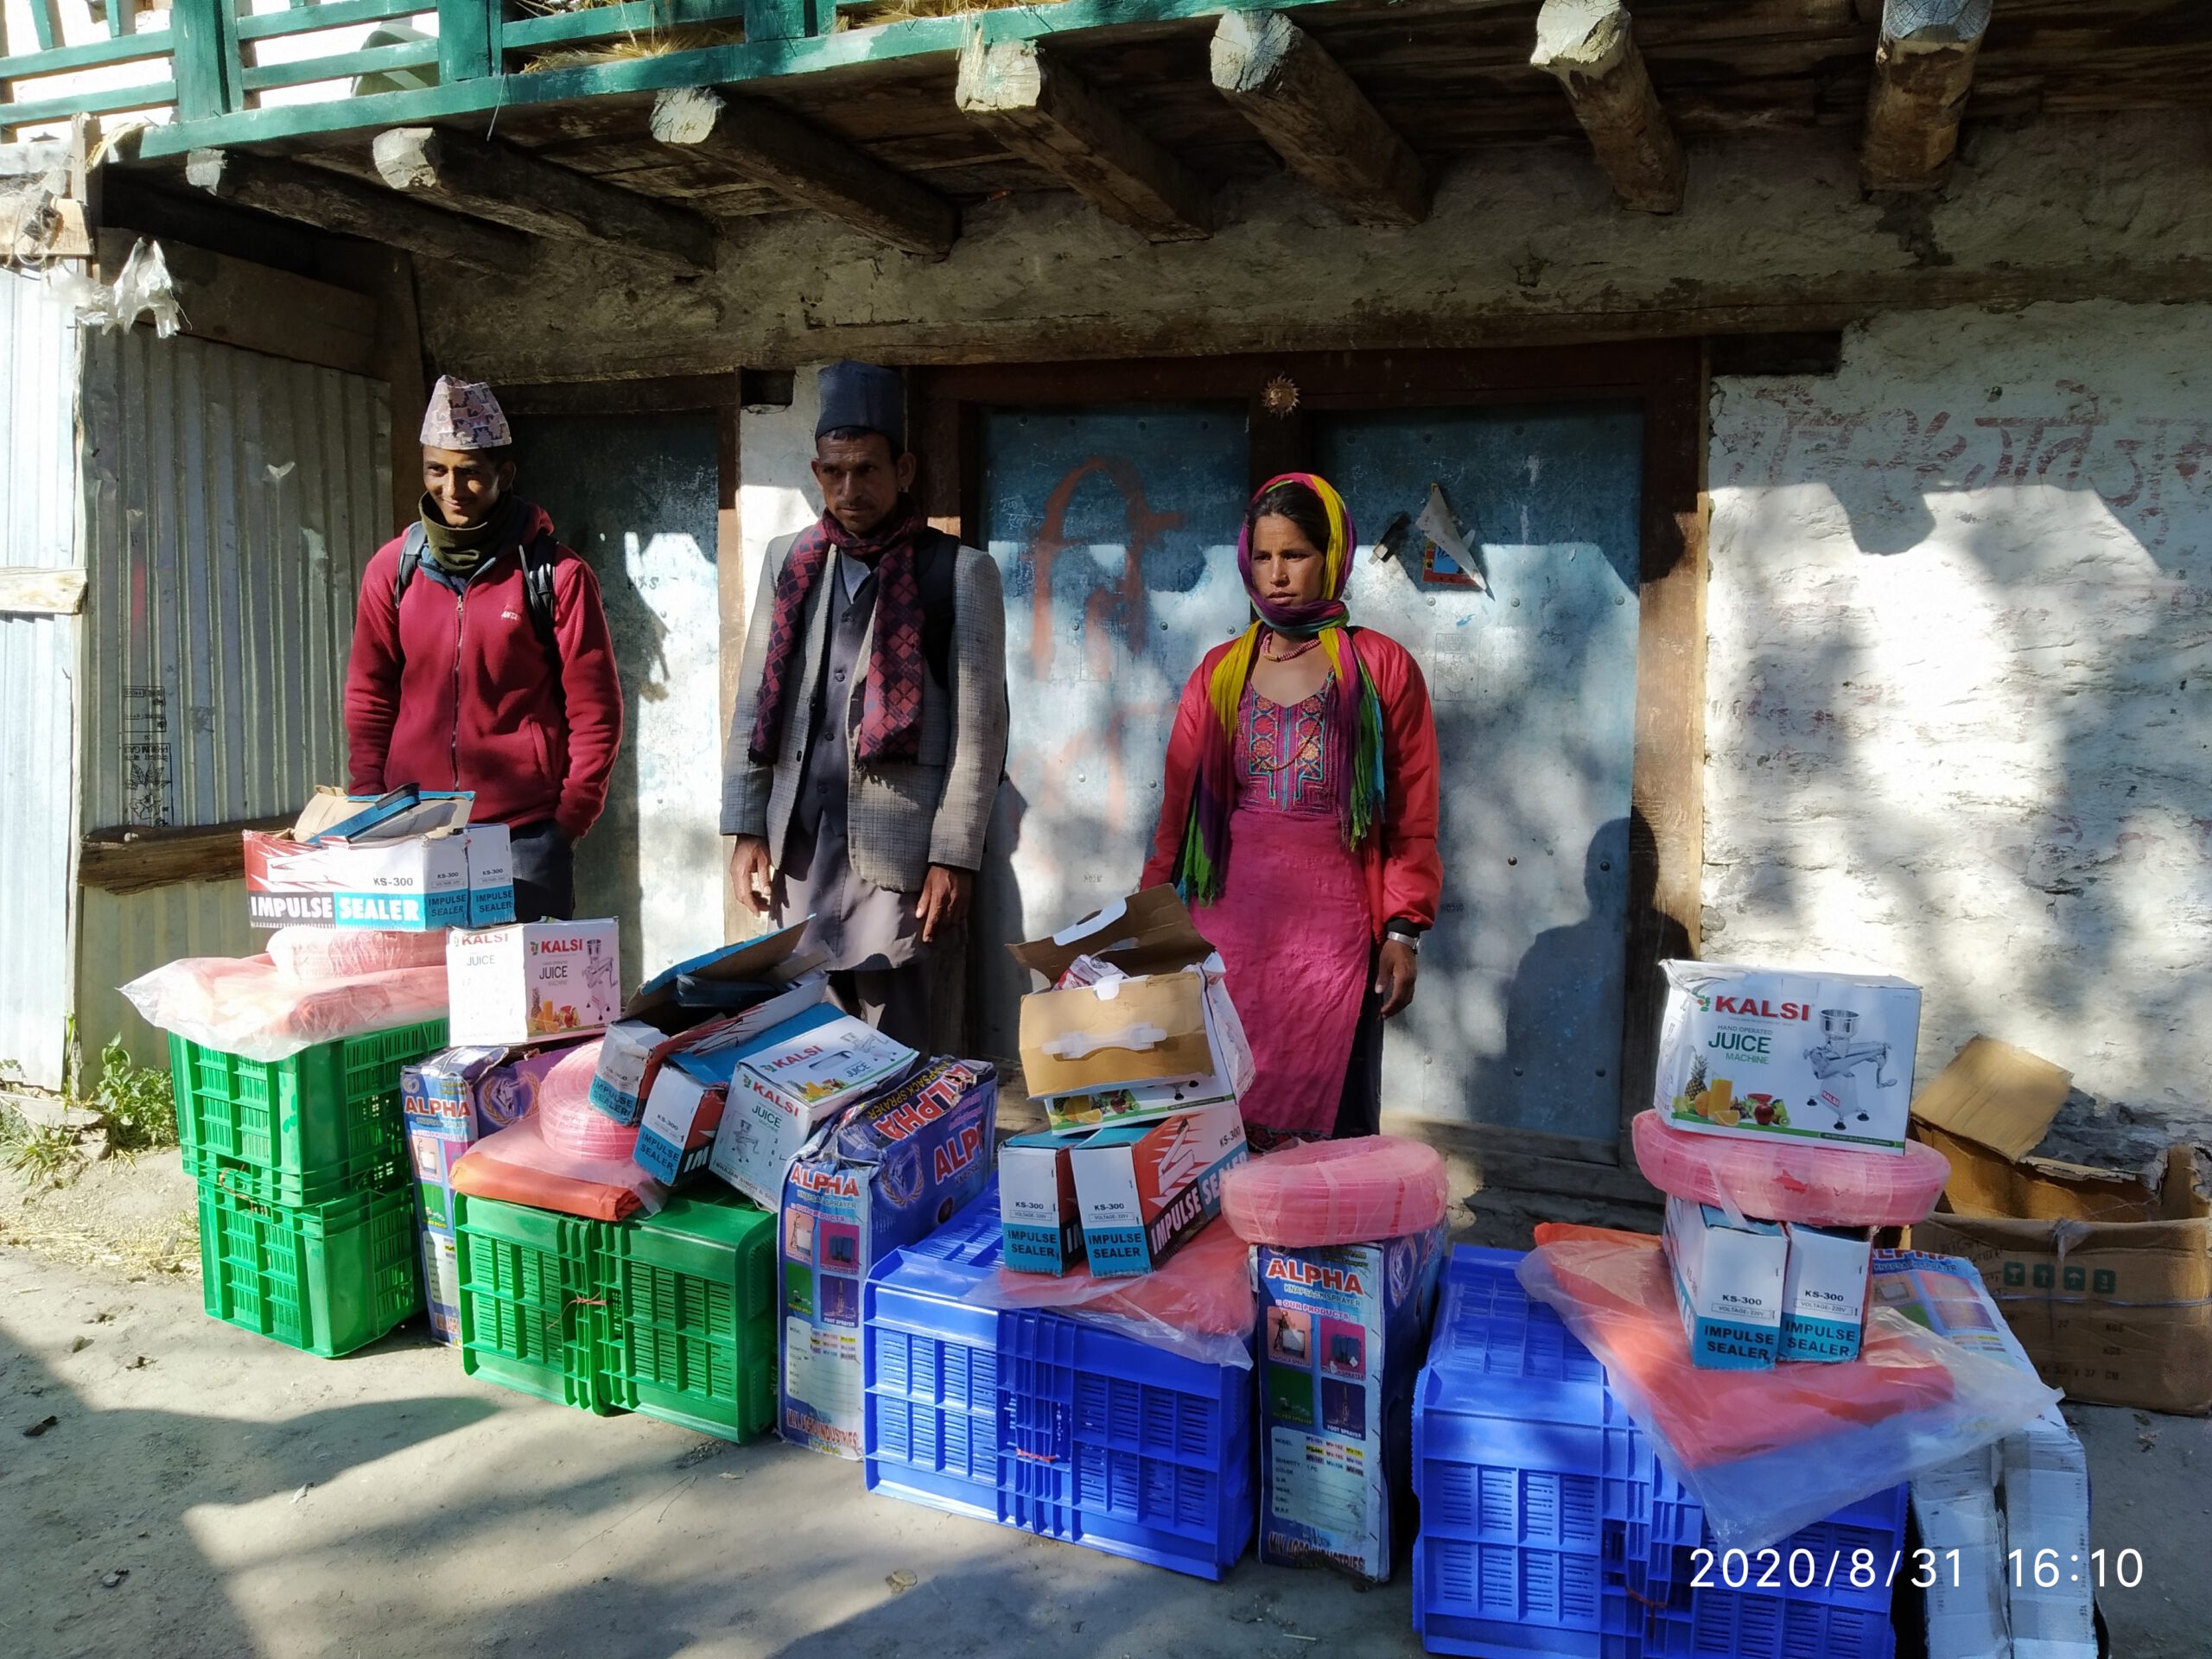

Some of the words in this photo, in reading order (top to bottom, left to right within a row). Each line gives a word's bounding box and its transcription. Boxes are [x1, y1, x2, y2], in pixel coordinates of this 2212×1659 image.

[373, 877, 413, 887] KS-300
[429, 894, 466, 906] IMPULSE
[476, 890, 512, 902] IMPULSE
[251, 893, 333, 918] IMPULSE
[340, 898, 420, 921] SEALER
[431, 906, 464, 917] SEALER
[480, 901, 512, 912] SEALER
[461, 933, 508, 946] KALSI
[541, 939, 583, 953] KALSI
[467, 955, 496, 966] JUICE
[539, 966, 568, 980] JUICE
[1715, 995, 1810, 1021] KALSI
[1738, 1027, 1773, 1036] OPERATED
[1708, 1033, 1771, 1053] JUICE
[772, 1046, 824, 1069] KALSI
[1726, 1052, 1770, 1065] MACHINE
[846, 1062, 871, 1077] JUICE
[595, 1080, 632, 1108] IMPULSE
[753, 1081, 799, 1119] KALSI
[1822, 1090, 1840, 1107] KALSI
[404, 1095, 471, 1118] ALPHA
[593, 1091, 631, 1116] SEALER
[868, 1091, 907, 1120] SPRAYER
[752, 1105, 782, 1128] JUICE
[1220, 1126, 1242, 1148] KS-300
[642, 1131, 680, 1162] IMPULSE
[640, 1143, 674, 1171] SEALER
[790, 1161, 861, 1198] ALPHA
[825, 1198, 857, 1210] SPRAYER
[1015, 1201, 1044, 1210] KS-300
[1150, 1186, 1202, 1255] IMPULSE
[1008, 1230, 1057, 1244] IMPULSE
[1088, 1232, 1141, 1245] IMPULSE
[1011, 1243, 1054, 1257] SEALER
[1093, 1248, 1141, 1259] SEALER
[1265, 1258, 1363, 1296] ALPHA
[1283, 1283, 1325, 1301] KNAPSACK
[1325, 1292, 1362, 1307] SPRAYER
[1722, 1294, 1763, 1306] KS-300
[1805, 1289, 1844, 1302] KS-300
[1282, 1300, 1302, 1311] OUR
[1303, 1304, 1350, 1320] PRODUCTS
[1705, 1325, 1775, 1345] IMPULSE
[1785, 1321, 1855, 1343] IMPULSE
[1707, 1341, 1770, 1361] SEALER
[1787, 1338, 1850, 1357] SEALER
[1341, 1427, 1363, 1438] SPRAYER
